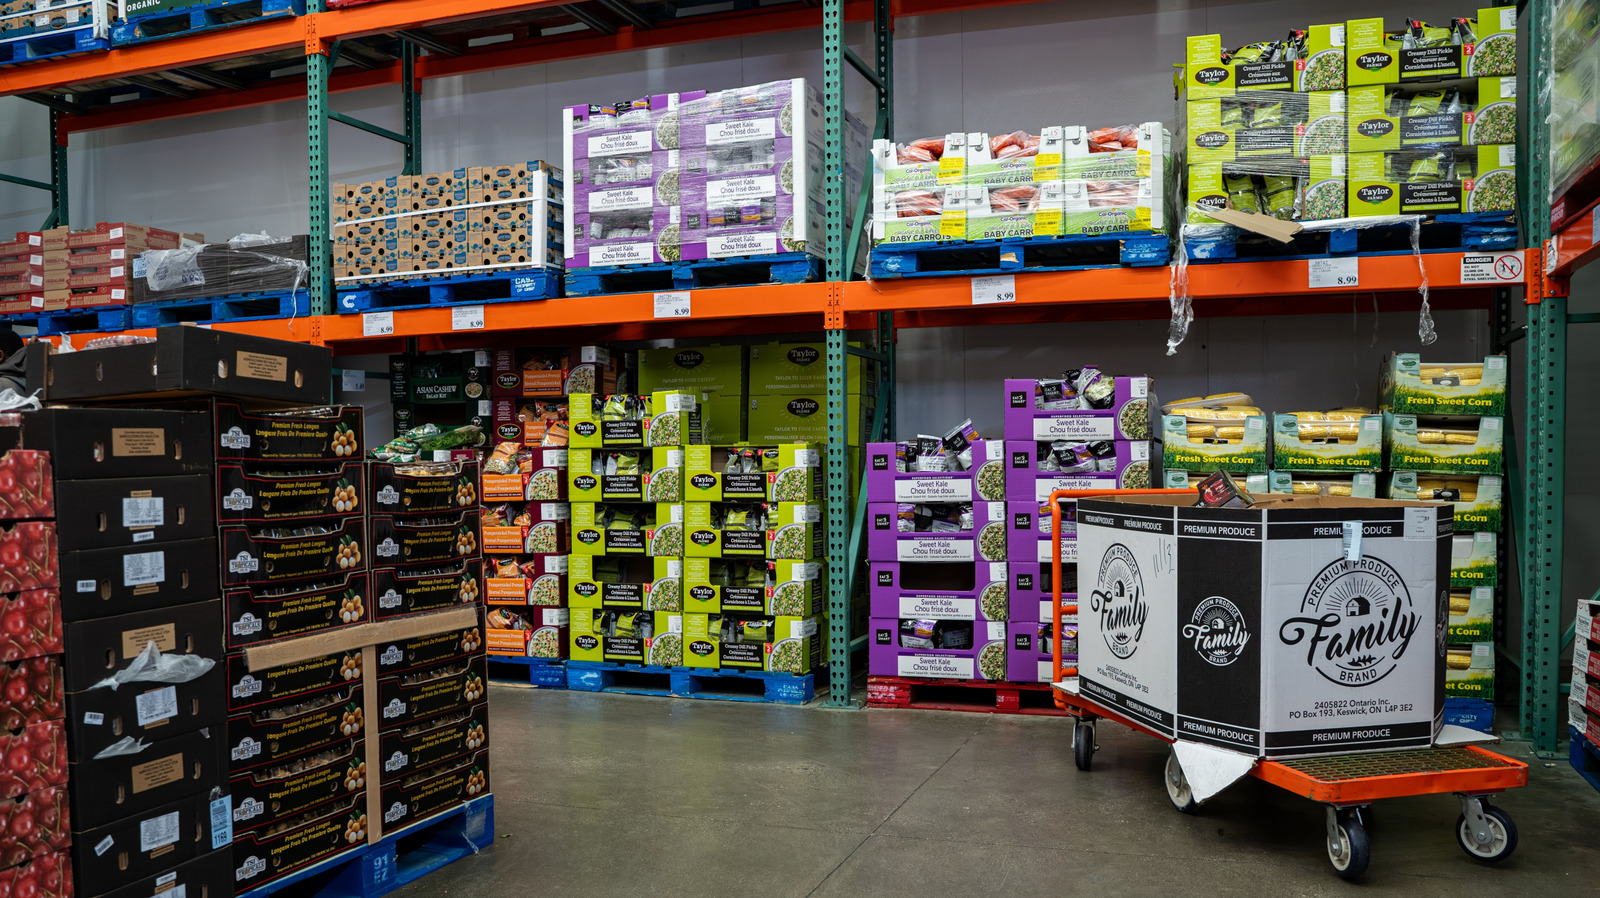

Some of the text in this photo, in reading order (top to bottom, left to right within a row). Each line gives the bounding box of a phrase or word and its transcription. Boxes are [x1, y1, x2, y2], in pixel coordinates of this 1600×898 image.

[126, 0, 160, 12] ORGANIC
[1360, 54, 1388, 64] Taylor
[984, 230, 1006, 238] BABY
[1337, 276, 1357, 285] 8.99
[997, 292, 1014, 301] 8.99
[674, 307, 689, 315] 8.99
[470, 320, 483, 328] 8.99
[416, 386, 433, 394] ASIAN
[791, 401, 816, 409] Taylor
[1407, 396, 1492, 406] Fresh Sweet Corn
[1202, 455, 1229, 463] Sweet
[1231, 456, 1254, 464] Corn
[1316, 457, 1344, 465] Sweet
[1347, 458, 1370, 466] Corn
[1085, 515, 1114, 525] PREMIUM PRODUCE
[1463, 514, 1487, 522] Corn
[1124, 520, 1162, 531] PREMIUM PRODUCE
[1184, 525, 1256, 536] PREMIUM PRODUCE
[1313, 527, 1343, 535] PREMIU
[1100, 547, 1138, 583] PREMIUM PRODUCE
[1307, 560, 1400, 606] PREMIUM PRODUCE
[1091, 586, 1149, 642] Family
[1195, 598, 1239, 620] PREMIUM PRODUCE
[1279, 596, 1422, 667] Family
[1182, 622, 1251, 656] Family
[1112, 642, 1129, 654] BRAND
[1209, 656, 1228, 664] BRAND
[930, 664, 943, 672] frisé
[1119, 669, 1131, 679] Ontario
[1339, 668, 1377, 682] BRAND
[1114, 674, 1128, 686] Keswick,
[1128, 680, 1134, 688] ON
[1458, 682, 1482, 691] Corn
[1086, 681, 1117, 701] PREMIUM PRODUCE
[1314, 698, 1390, 710] 2405822 Ontario Inc.
[1126, 699, 1162, 721] PREMIUM PRODUCE
[1289, 704, 1413, 719] PO Box 193, Keswick, ON L4P 3E2
[1183, 721, 1254, 743] PREMIUM PRODUCE
[1312, 729, 1390, 742] PREMIUM PRODUCE
[214, 831, 227, 845] 1169
[374, 853, 388, 870] 91
